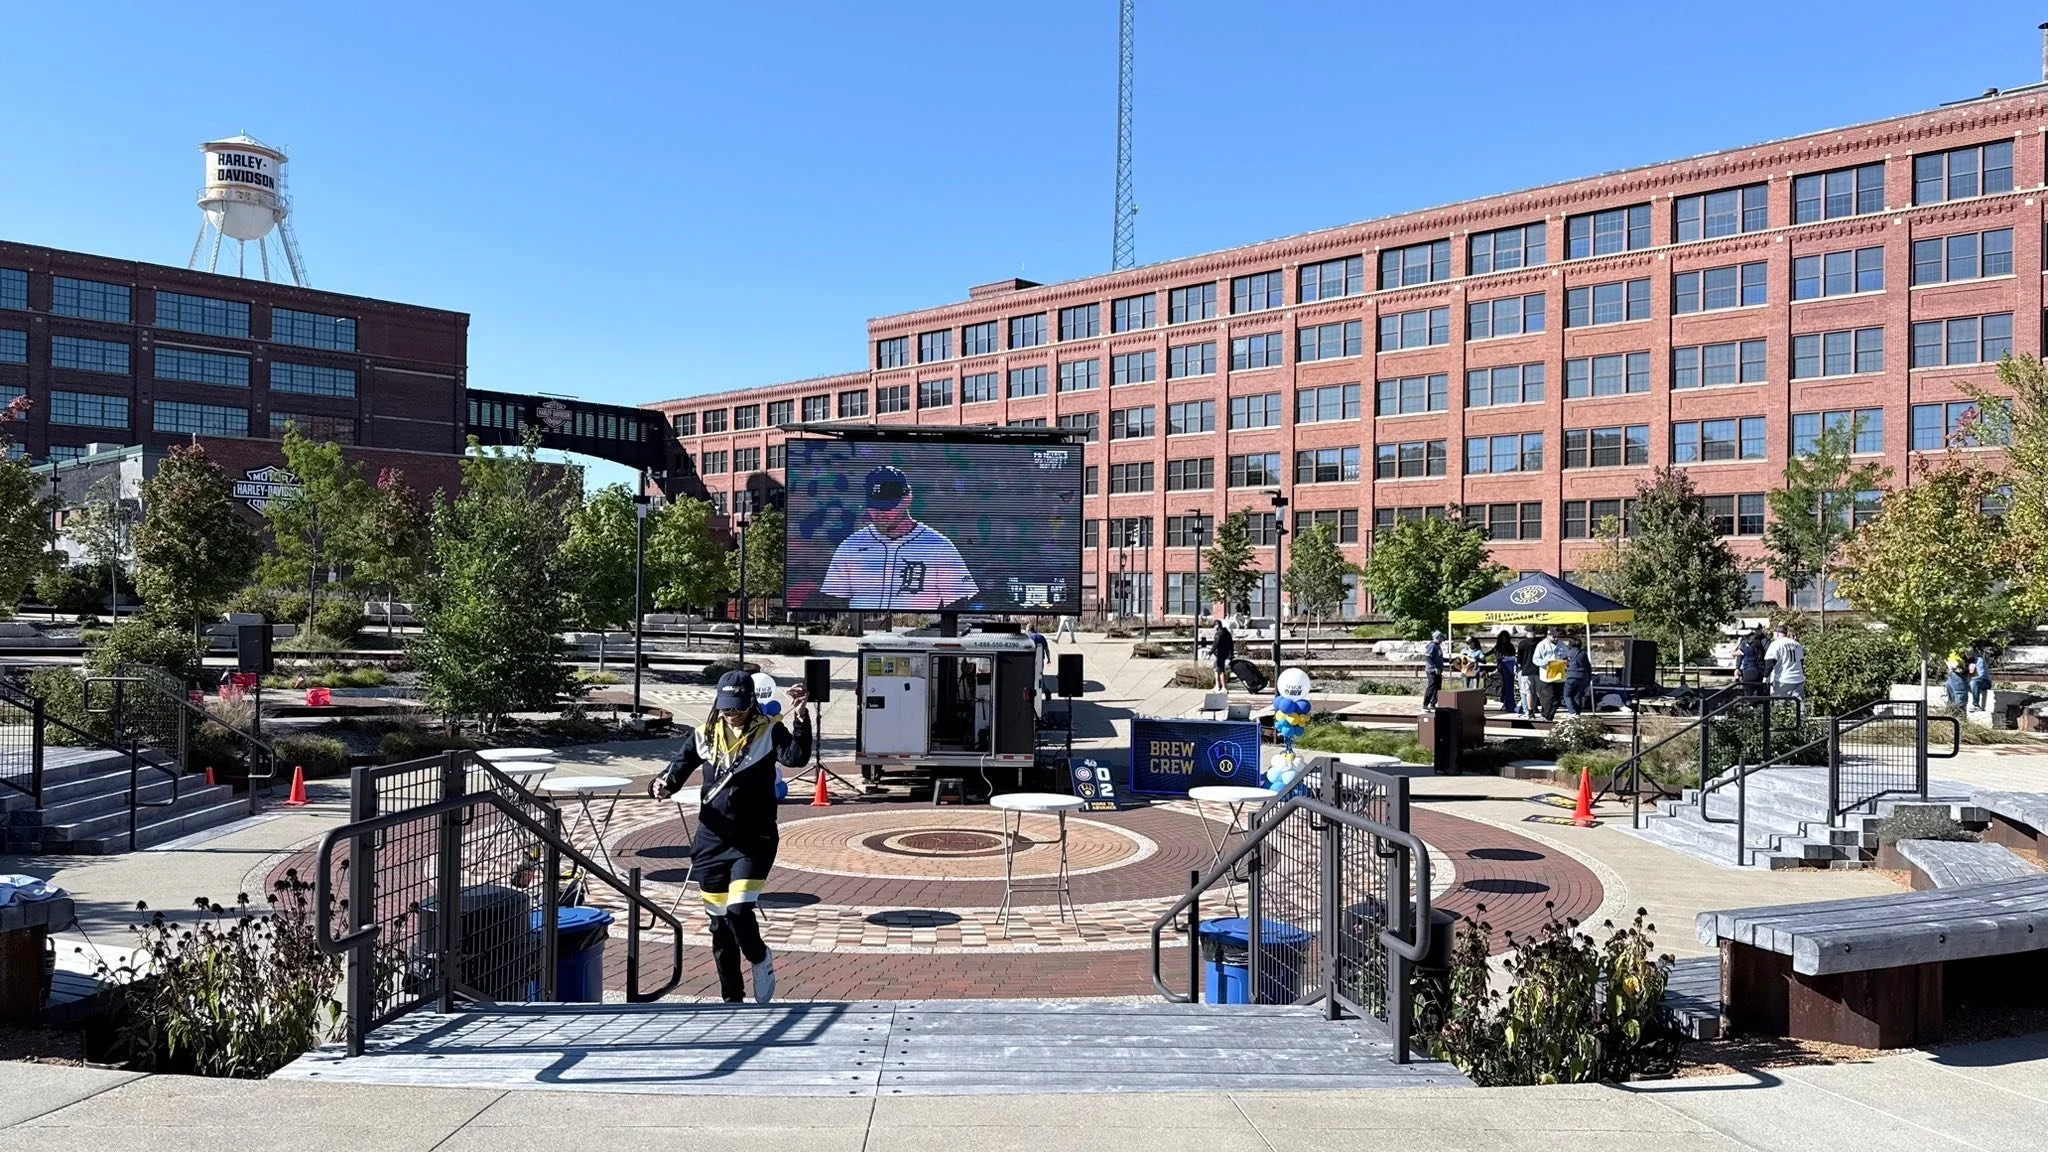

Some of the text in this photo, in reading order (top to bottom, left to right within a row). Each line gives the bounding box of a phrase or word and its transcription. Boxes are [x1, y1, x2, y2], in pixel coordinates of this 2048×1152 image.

[218, 153, 267, 170] HARLEY-
[217, 169, 275, 190] DAVIDSON
[1484, 612, 1549, 622] MILWAUKEE
[1150, 741, 1195, 757] BREW
[1096, 767, 1111, 781] 0
[1150, 758, 1195, 775] CREW
[1100, 783, 1115, 797] 2
